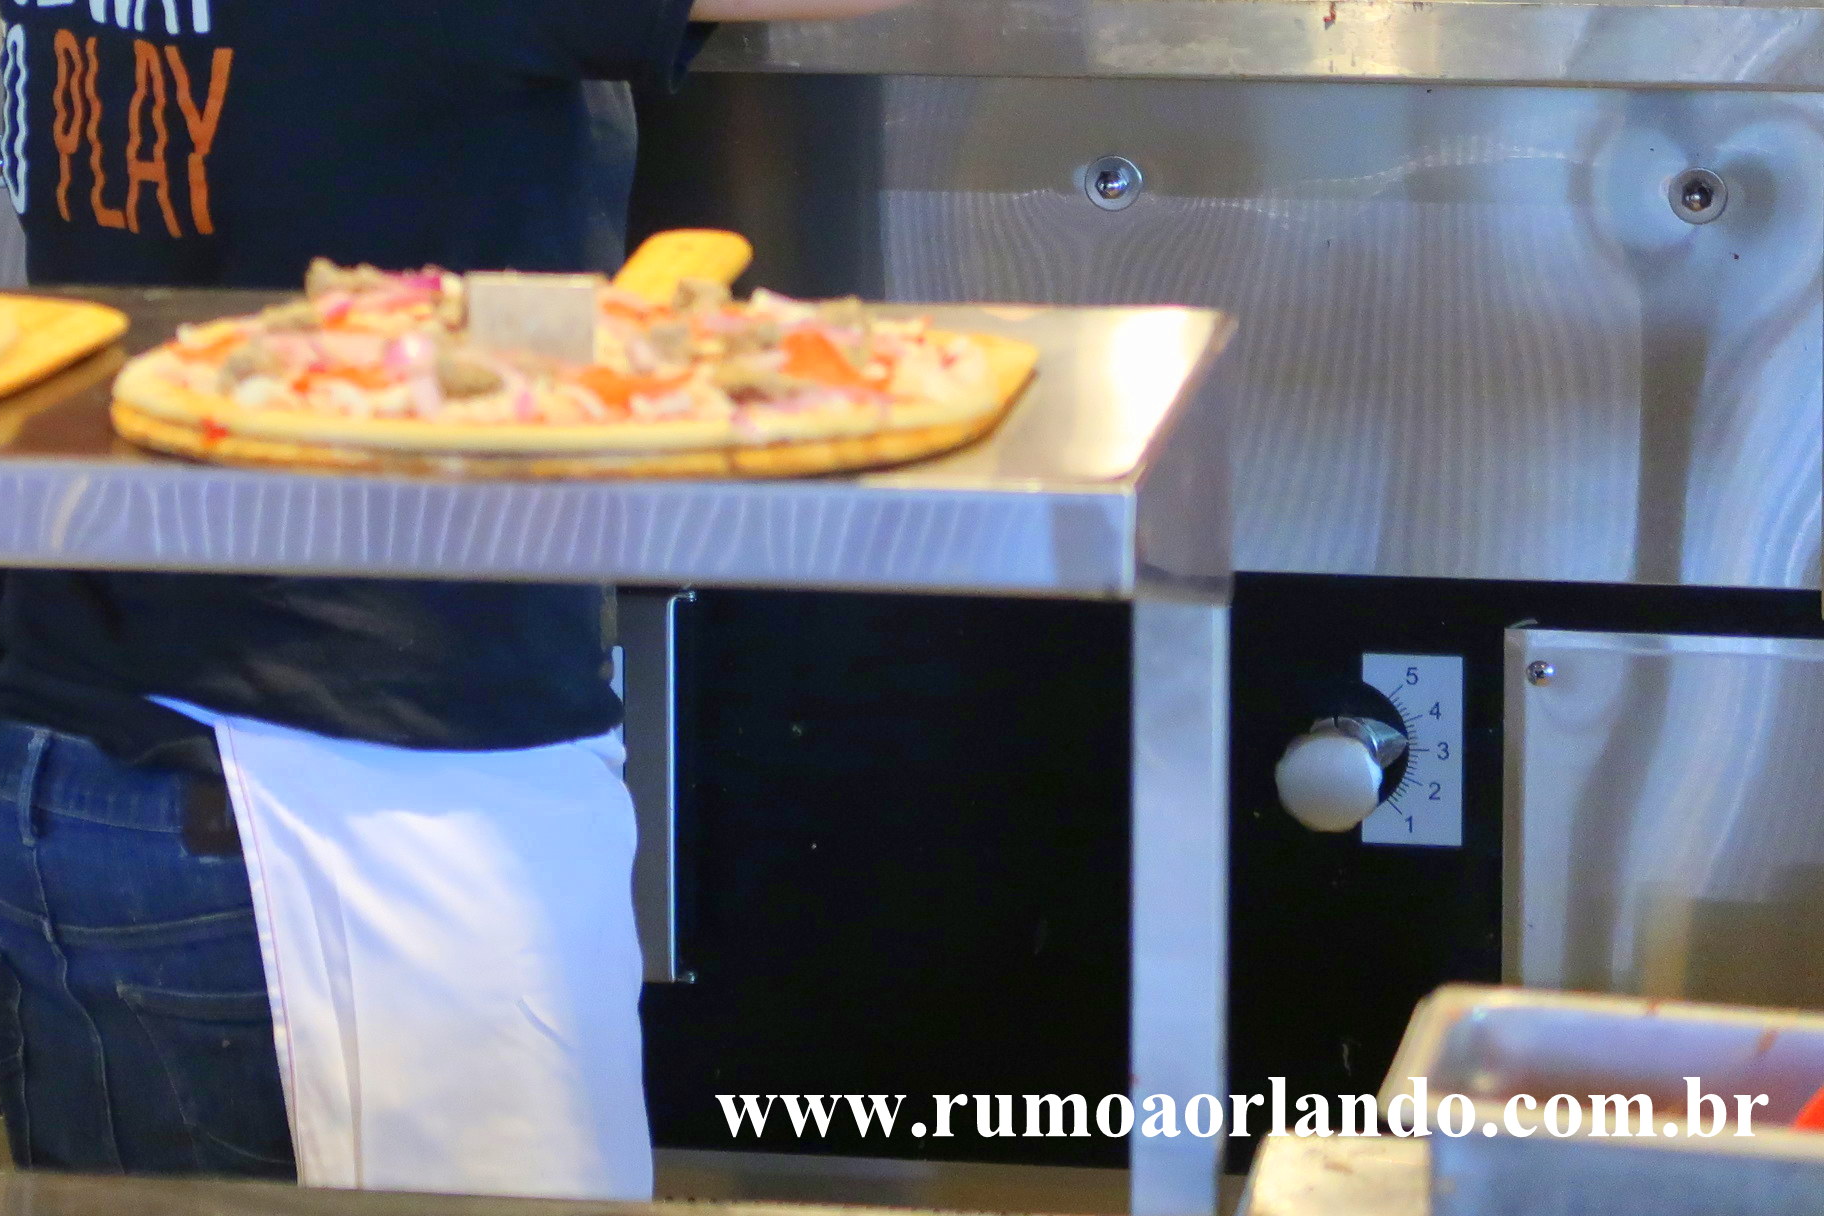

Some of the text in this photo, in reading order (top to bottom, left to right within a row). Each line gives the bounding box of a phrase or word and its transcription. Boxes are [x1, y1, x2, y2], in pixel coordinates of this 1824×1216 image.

[53, 28, 234, 238] PLAY
[1405, 666, 1420, 685] 5
[1428, 701, 1442, 720] 4
[1436, 741, 1451, 761] 3
[1428, 782, 1442, 801] 2
[1404, 815, 1414, 834] 1
